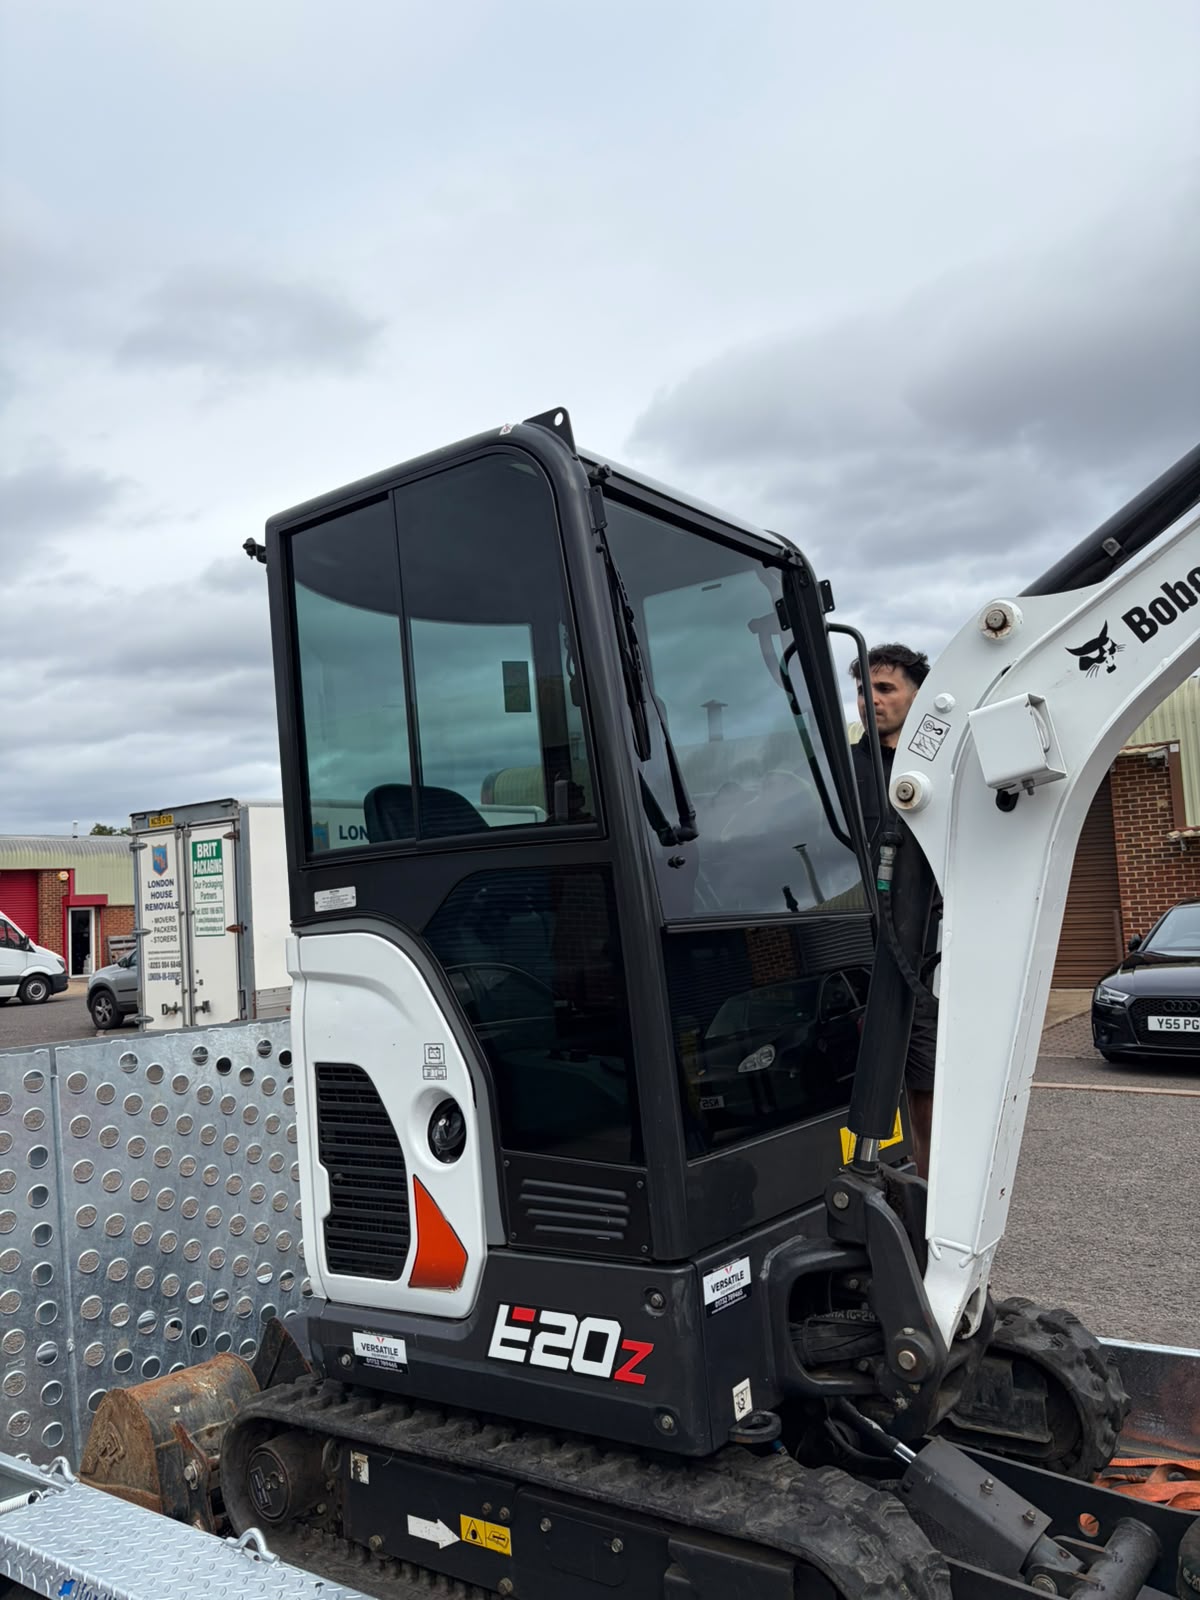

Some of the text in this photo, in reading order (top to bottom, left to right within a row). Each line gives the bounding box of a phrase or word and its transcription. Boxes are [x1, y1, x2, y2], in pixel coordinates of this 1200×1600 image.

[196, 842, 218, 858] BRIT
[193, 859, 223, 875] PACKAGING
[147, 879, 174, 888] LONDON
[150, 890, 173, 900] HOUSE
[145, 901, 179, 911] REMOVALS
[154, 916, 176, 924] MOVERS
[153, 925, 178, 933] PACKERS
[153, 935, 178, 943] STORERS
[1157, 1018, 1181, 1030] Y55
[711, 1270, 745, 1294] VERSATILE
[361, 1342, 399, 1357] VERSATILE
